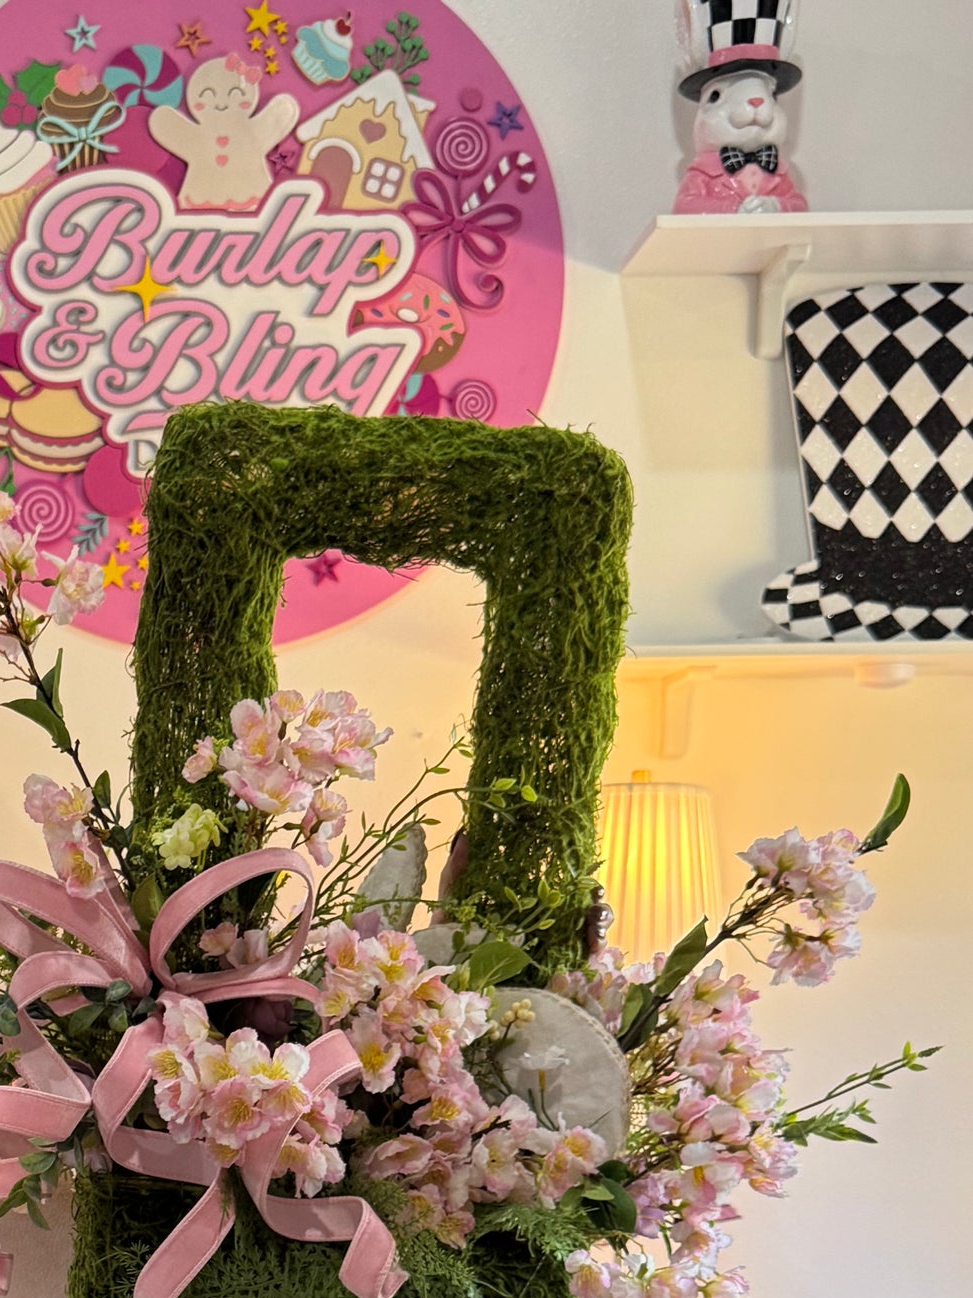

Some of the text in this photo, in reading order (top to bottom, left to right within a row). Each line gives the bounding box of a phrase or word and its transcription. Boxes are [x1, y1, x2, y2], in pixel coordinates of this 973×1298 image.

[28, 184, 400, 315] Burlap
[33, 299, 406, 415] & Bling
